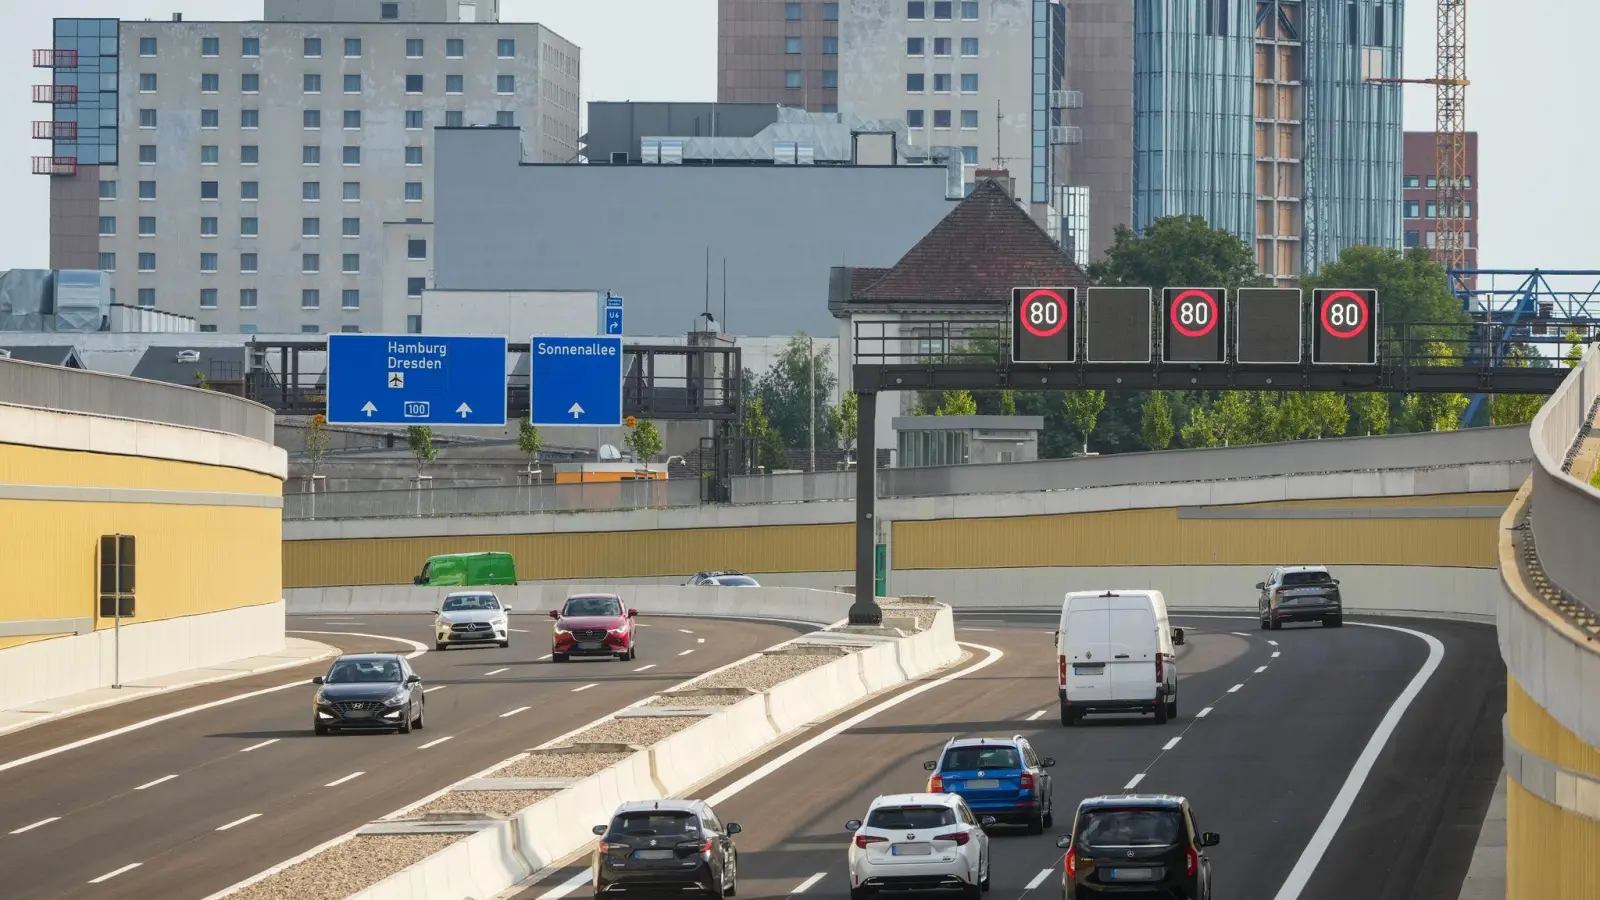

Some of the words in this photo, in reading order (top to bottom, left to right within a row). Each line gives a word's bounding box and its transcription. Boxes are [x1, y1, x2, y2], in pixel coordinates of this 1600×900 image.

[1030, 302, 1057, 324] 80
[1180, 302, 1208, 325] 80
[1331, 303, 1358, 326] 80
[388, 341, 447, 357] Hamburg
[538, 343, 616, 356] Sonnenallee
[388, 357, 442, 369] Dresden
[408, 404, 425, 414] 100
